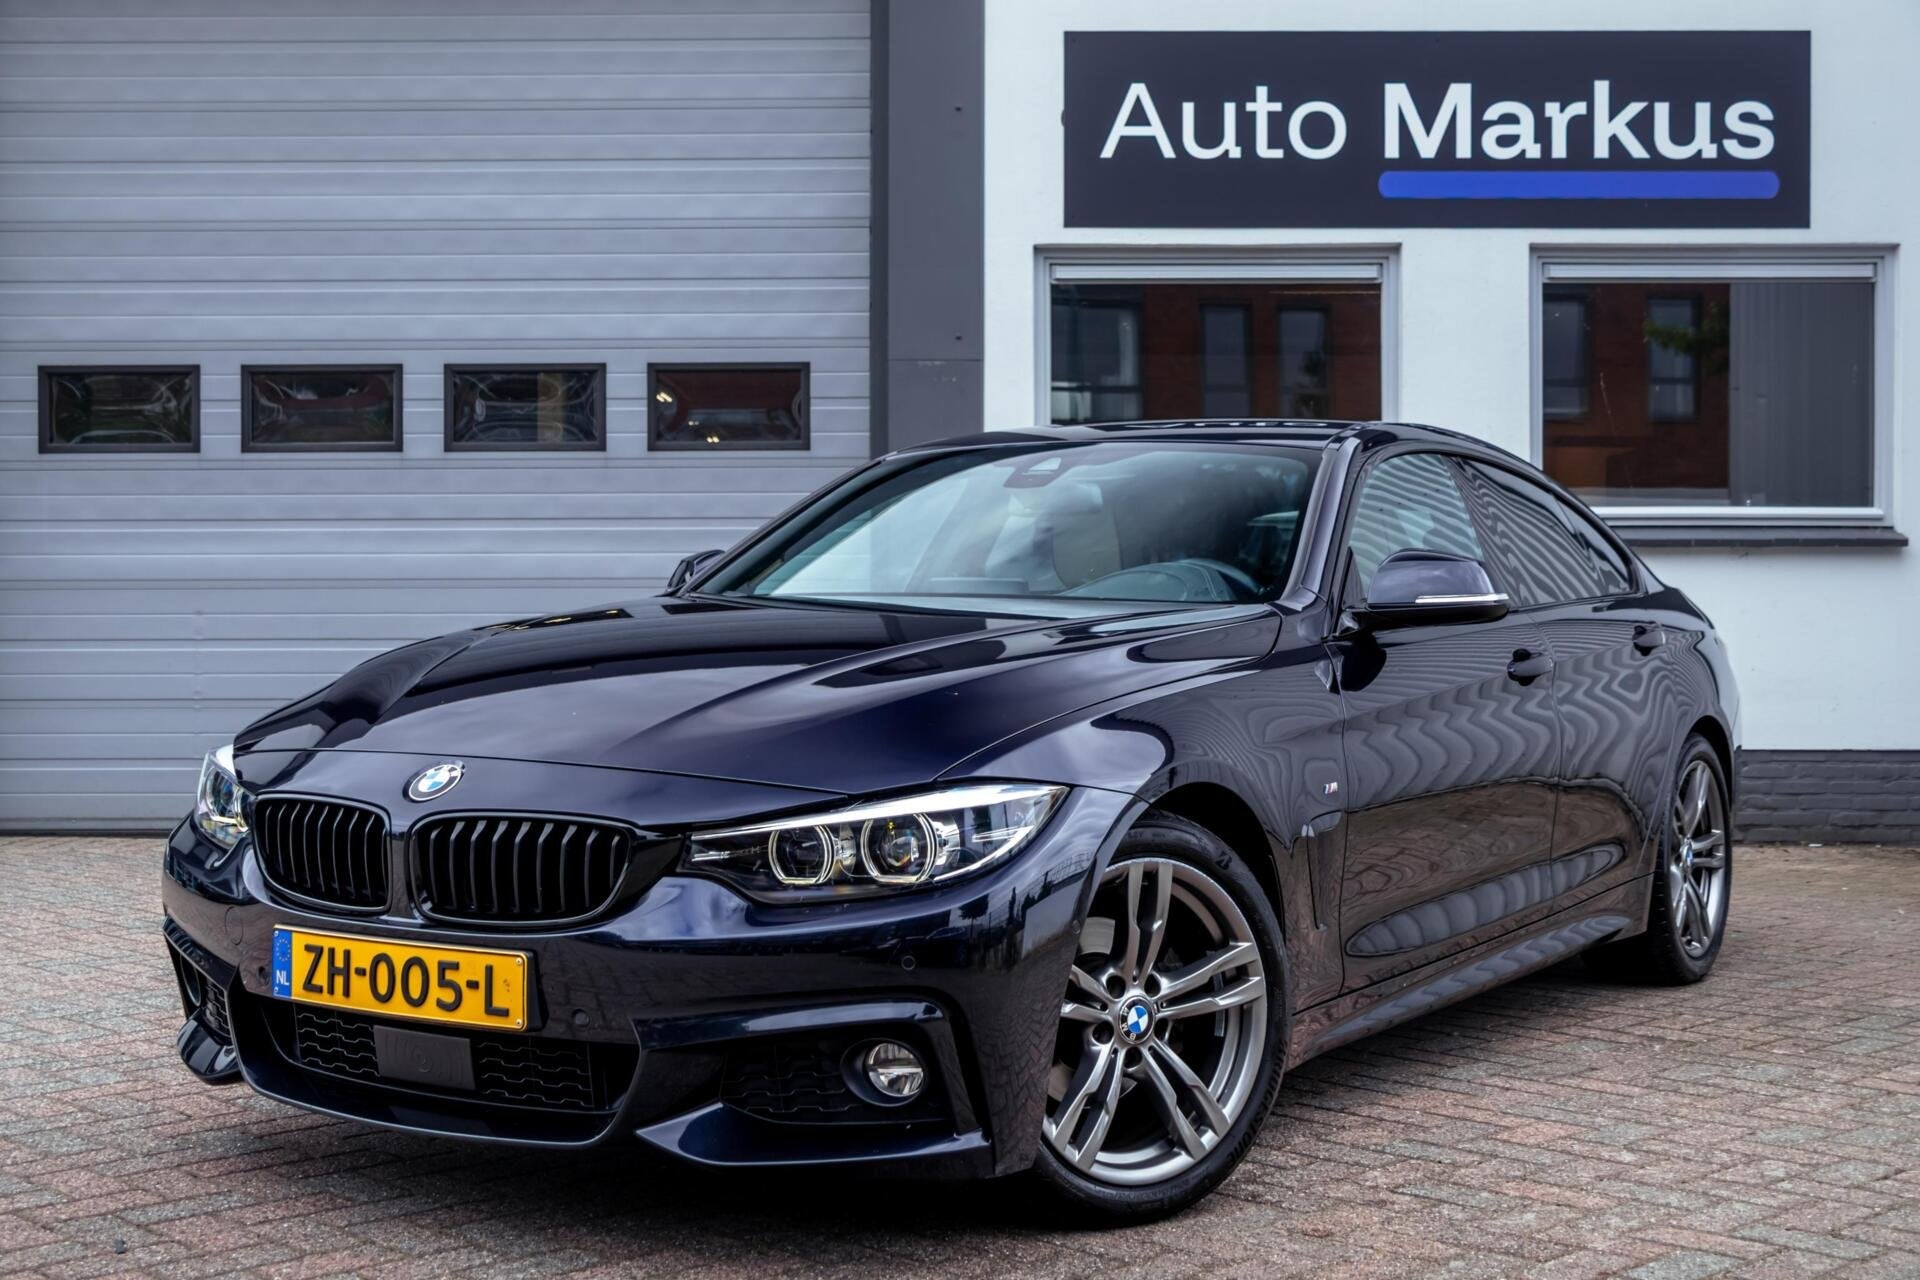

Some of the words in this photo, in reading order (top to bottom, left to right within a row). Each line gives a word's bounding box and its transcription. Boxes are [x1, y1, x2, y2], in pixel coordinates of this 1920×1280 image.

[1100, 83, 1347, 160] Auto
[1384, 80, 1775, 160] Markus
[276, 970, 290, 986] NL
[302, 943, 510, 1018] ZH-005-L
